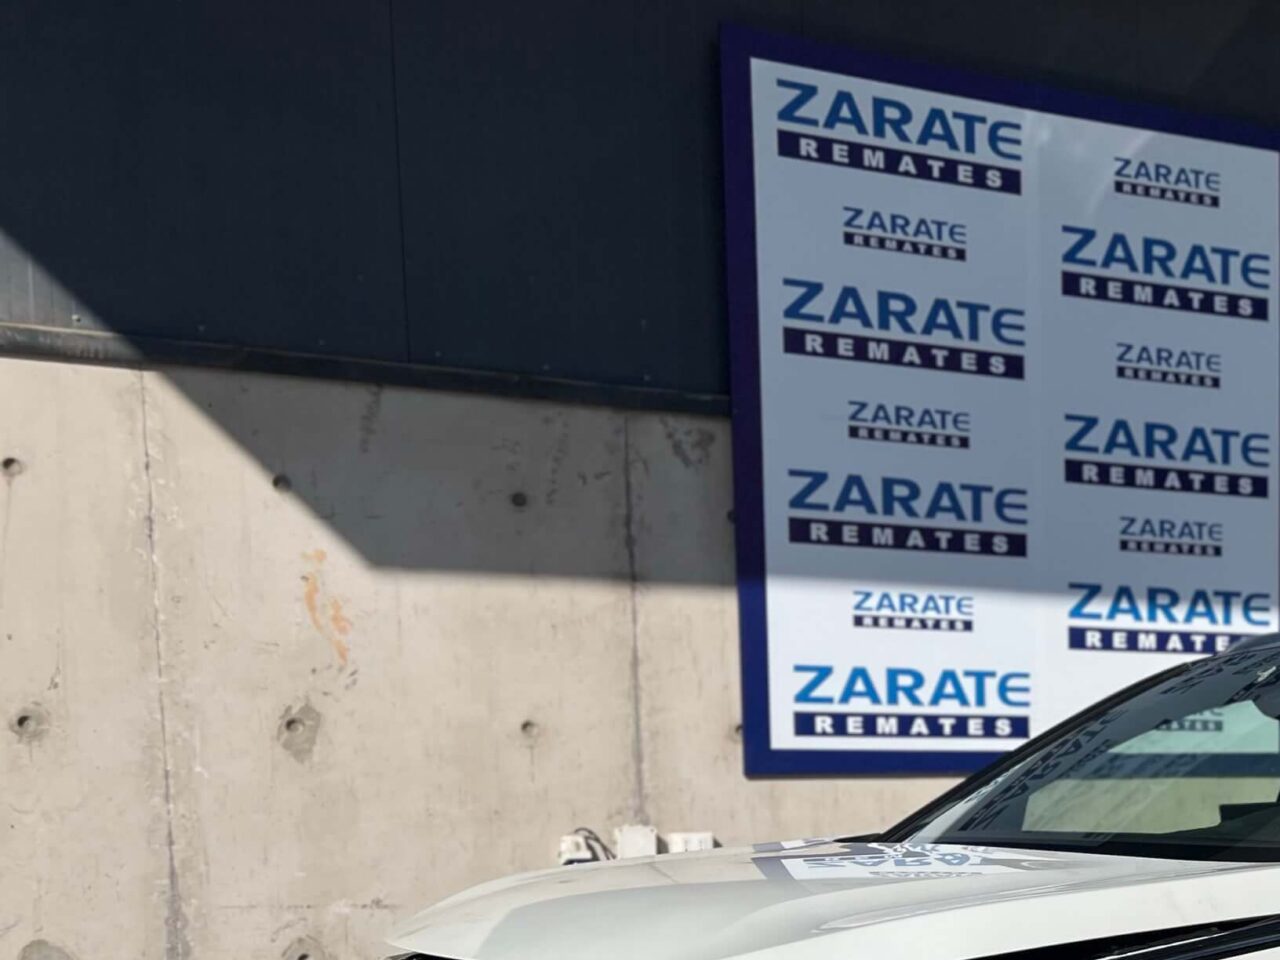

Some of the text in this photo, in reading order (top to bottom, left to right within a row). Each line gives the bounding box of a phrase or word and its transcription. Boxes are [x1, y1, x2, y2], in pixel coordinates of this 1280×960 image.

[776, 78, 1022, 161] ZARATE
[799, 137, 1003, 188] REMATES
[1114, 157, 1221, 191] ZARATE
[843, 206, 967, 244] ZARATE
[1061, 224, 1270, 290] ZARATE
[782, 277, 1026, 347] ZARATE
[1080, 276, 1254, 317] REMATES
[804, 332, 1006, 374] REMATES
[1117, 343, 1222, 373] ZARATE
[848, 401, 970, 433] ZARATE
[1064, 414, 1270, 467] ZARATE
[787, 469, 1028, 525] ZARATE
[1082, 462, 1254, 495] REMATES
[809, 521, 1009, 554] REMATES
[1120, 516, 1223, 542] ZARATE
[853, 590, 974, 617] ZARATE
[1067, 583, 1270, 625] ZARATE
[1086, 629, 1230, 651] REMATE
[794, 665, 1031, 707] ZARATE
[815, 715, 1012, 736] REMATES
